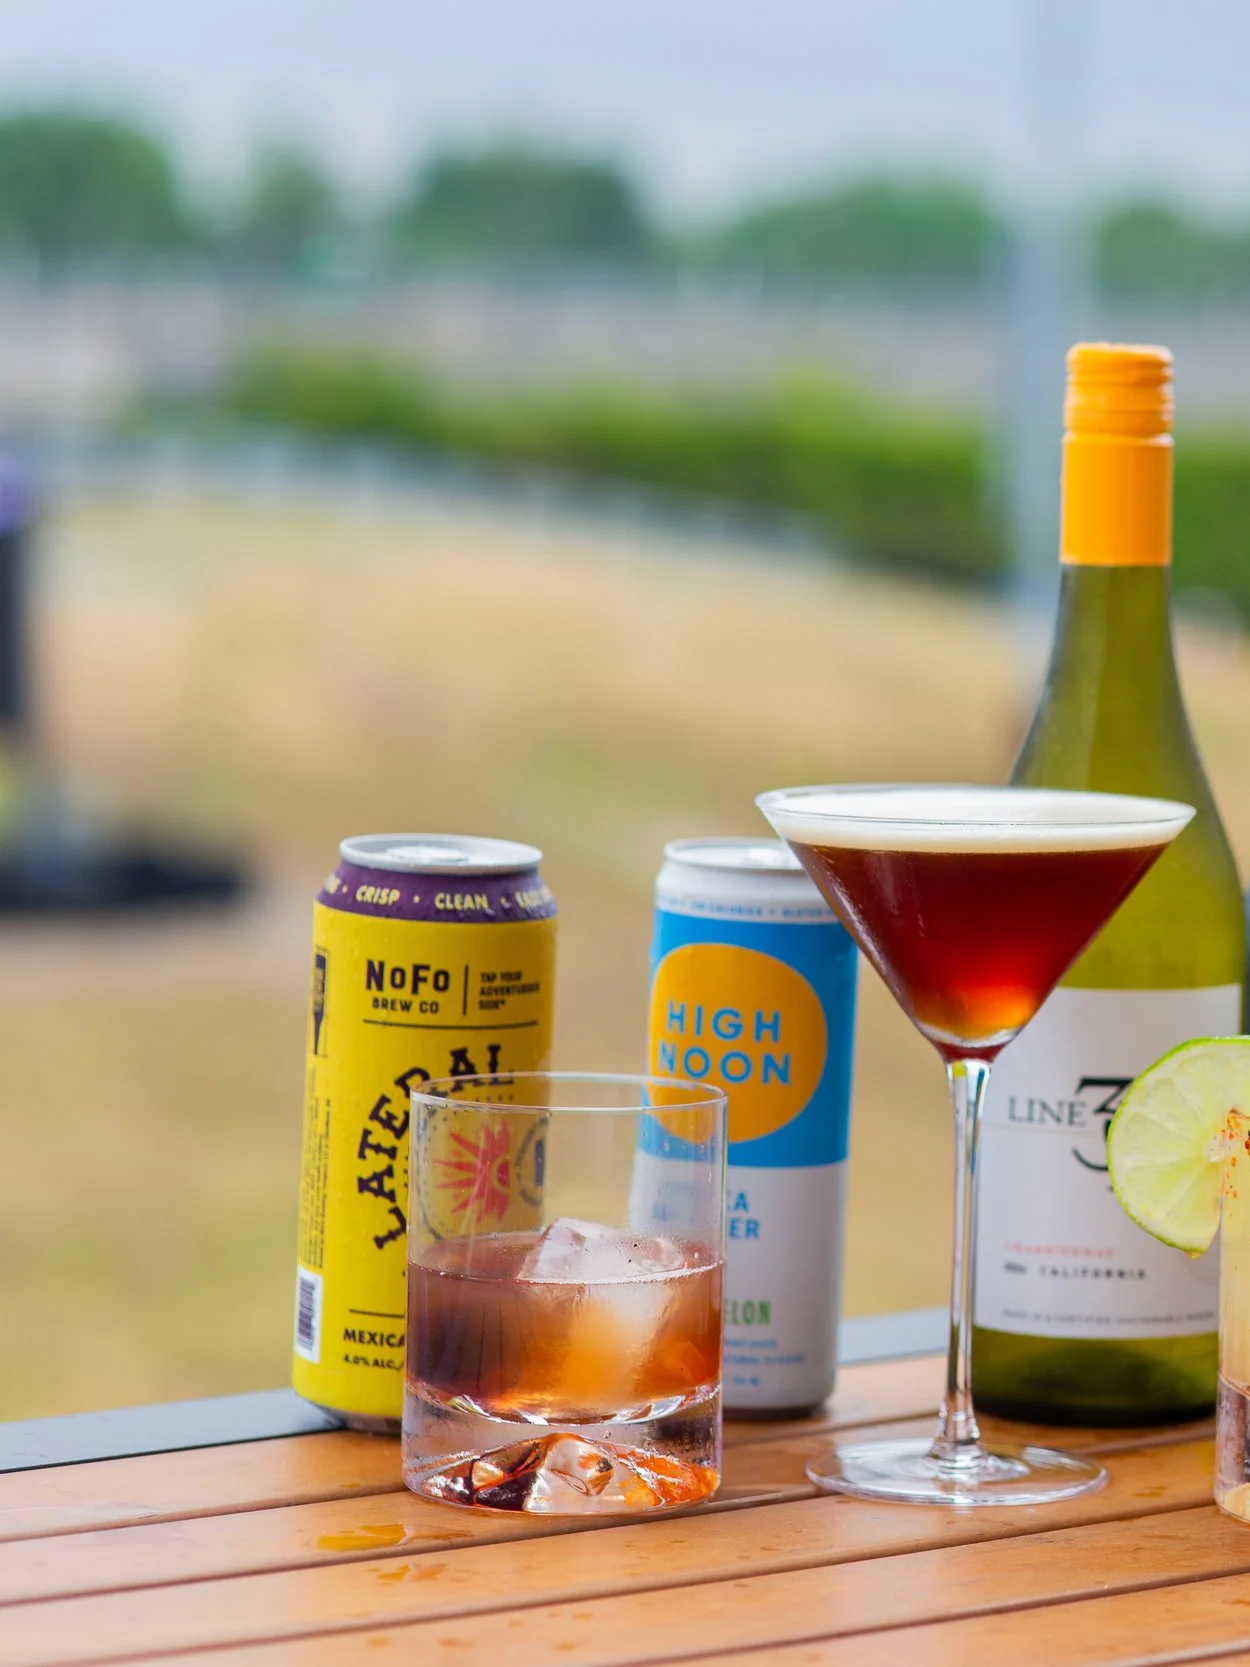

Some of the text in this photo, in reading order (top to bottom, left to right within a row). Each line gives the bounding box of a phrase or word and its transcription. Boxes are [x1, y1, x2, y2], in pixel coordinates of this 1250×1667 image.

[355, 884, 402, 905] CRISP
[434, 892, 490, 911] CLEAN
[365, 958, 451, 995] NoFo
[371, 997, 440, 1015] BREW CO
[667, 1000, 782, 1044] HIGH
[658, 1040, 792, 1085] NOON
[1008, 1095, 1089, 1128] LINE
